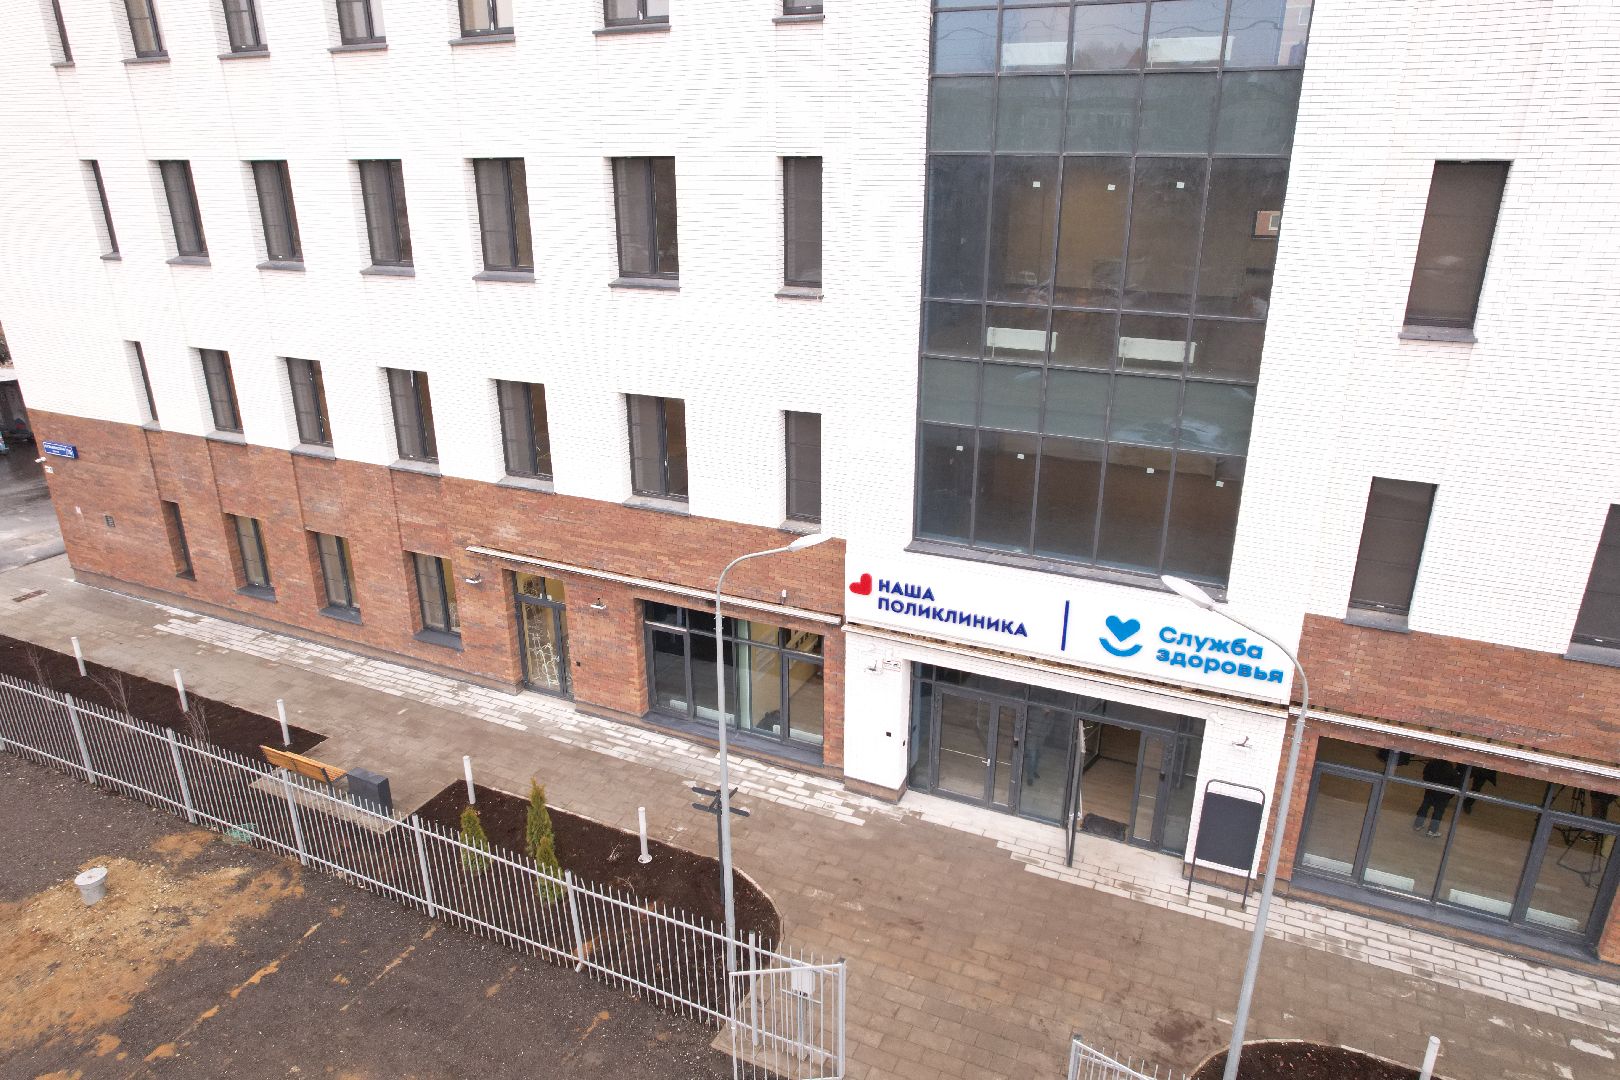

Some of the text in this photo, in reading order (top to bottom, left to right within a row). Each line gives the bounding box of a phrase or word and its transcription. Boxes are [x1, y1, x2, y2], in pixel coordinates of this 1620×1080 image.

[878, 579, 935, 601] НАША
[877, 597, 1028, 638] ПОЛИКЛИНИКА
[1158, 625, 1264, 661] Служба
[1155, 647, 1285, 685] здоровья
